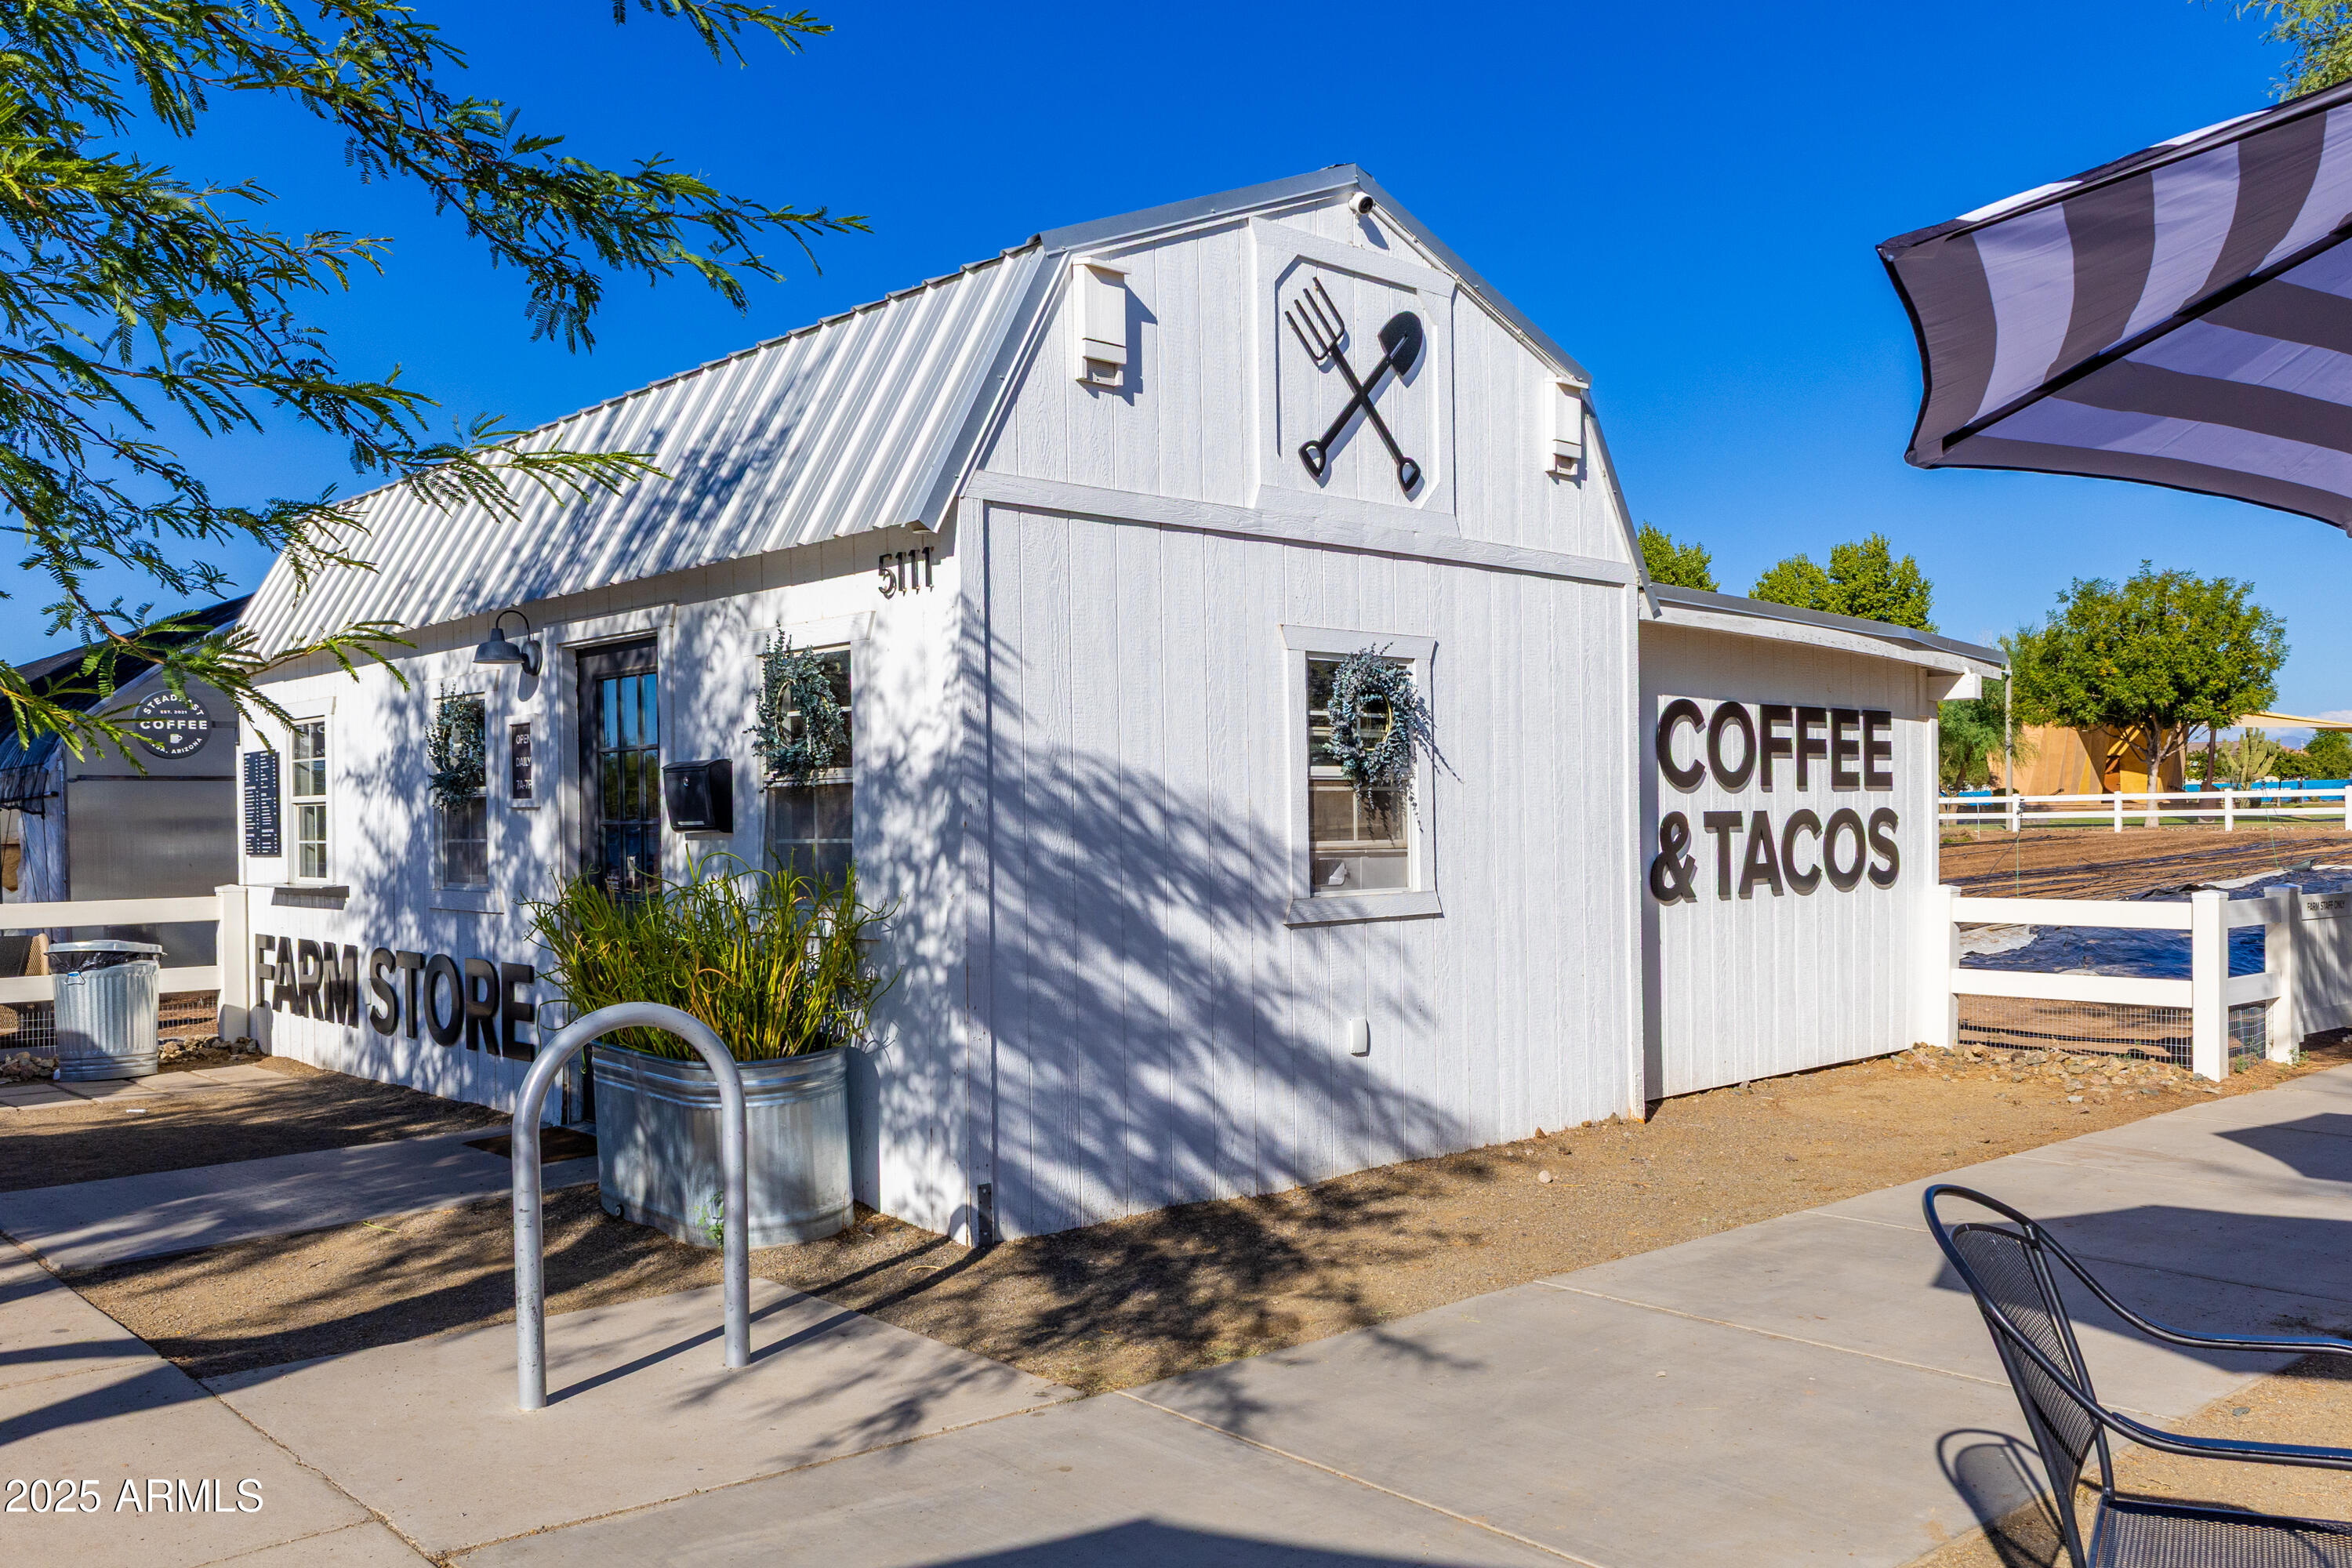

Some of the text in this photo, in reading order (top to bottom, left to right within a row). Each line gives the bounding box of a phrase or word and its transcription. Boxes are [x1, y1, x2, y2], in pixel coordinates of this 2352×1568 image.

[878, 546, 932, 596] 5111
[143, 694, 205, 716] STEADST
[140, 720, 208, 730] COFFEE
[171, 738, 202, 754] ARIZONA
[1656, 699, 1893, 793] COFFEE
[516, 757, 532, 767] DAILY
[1650, 808, 1900, 906] & TACOS
[2307, 900, 2345, 911] FARM STAFF ONLY
[255, 933, 535, 1062] FARM STORE
